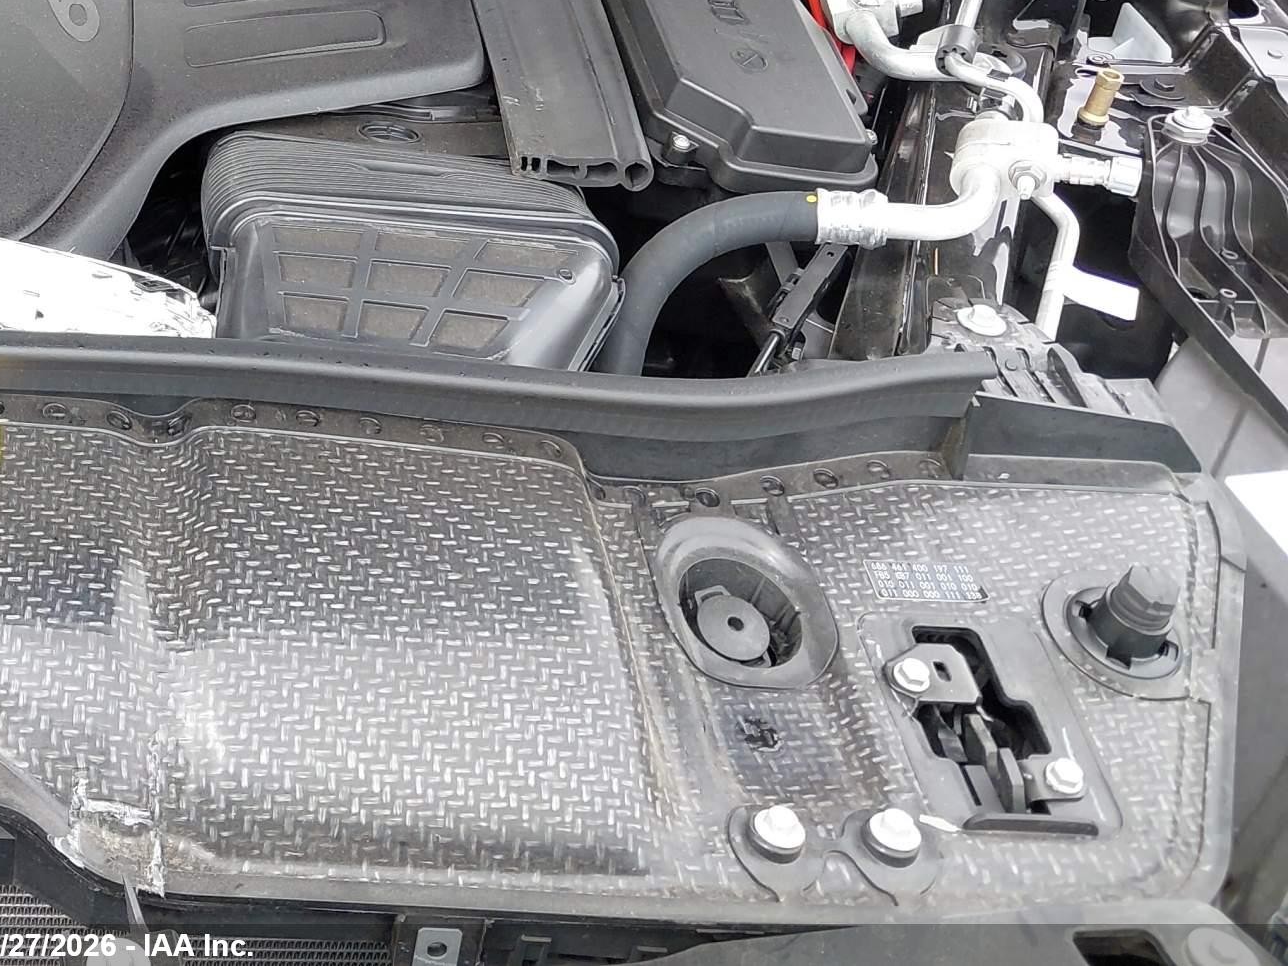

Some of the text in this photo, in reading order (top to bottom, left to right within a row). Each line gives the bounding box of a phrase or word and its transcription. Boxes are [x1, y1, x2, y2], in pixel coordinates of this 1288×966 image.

[953, 565, 969, 574] 111
[915, 572, 932, 581] 011
[898, 580, 915, 589] 011
[940, 582, 957, 591] 010
[961, 583, 978, 591] 010
[880, 588, 898, 597] 011
[944, 591, 961, 599] 111
